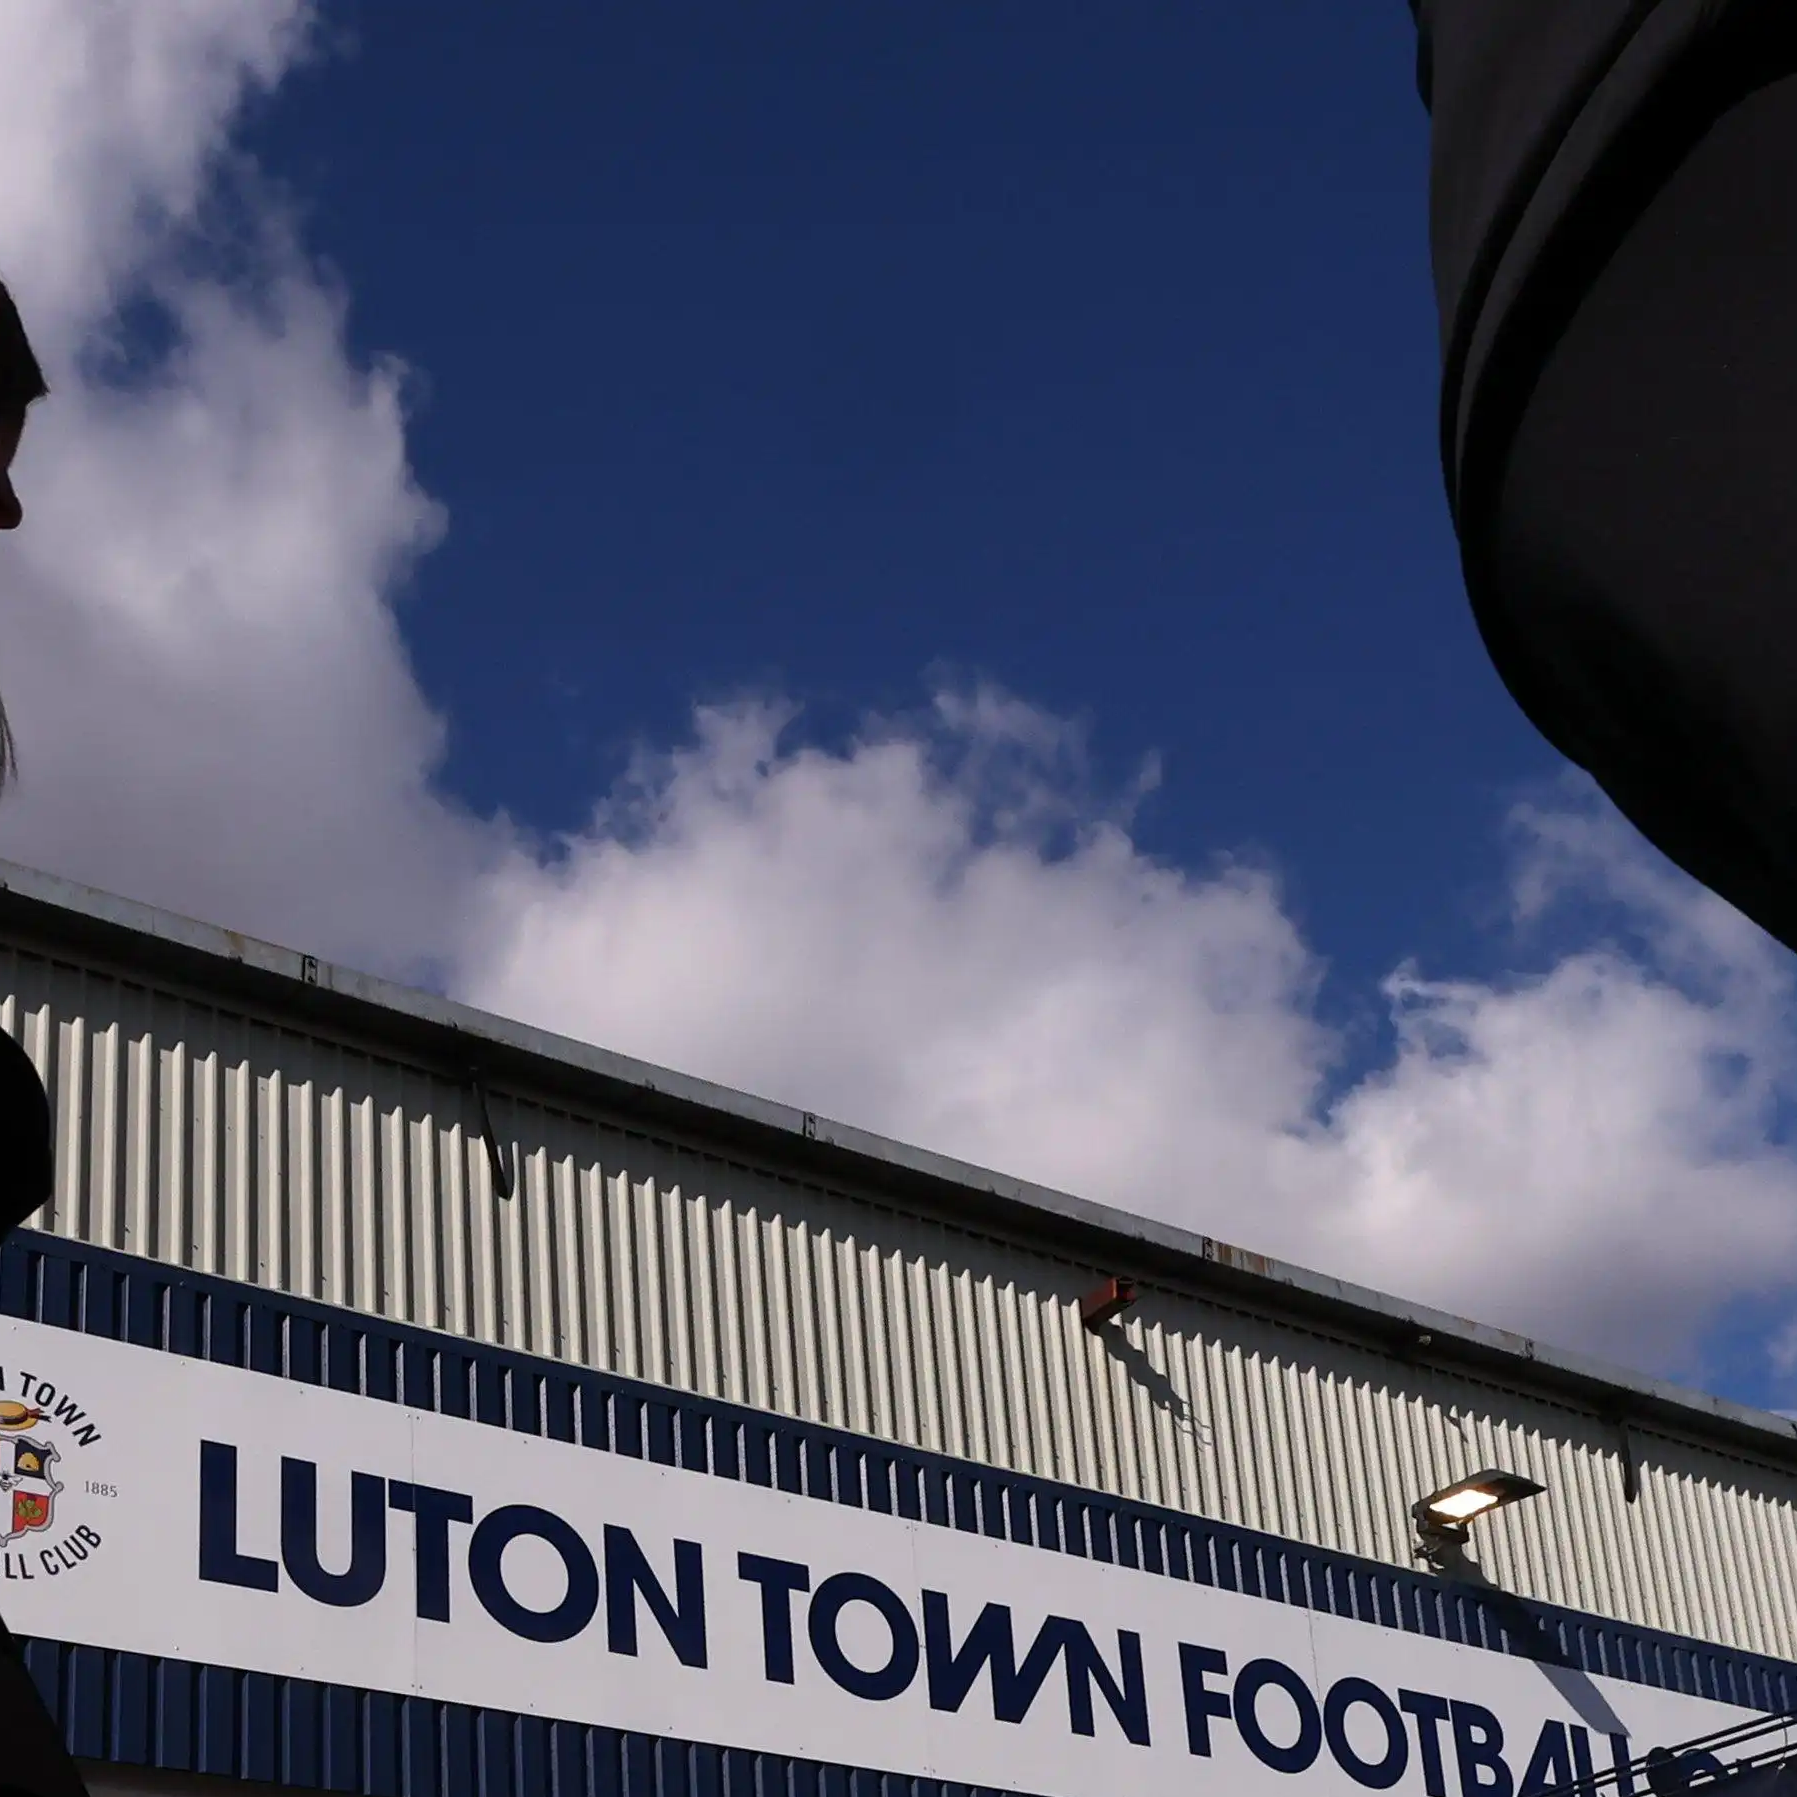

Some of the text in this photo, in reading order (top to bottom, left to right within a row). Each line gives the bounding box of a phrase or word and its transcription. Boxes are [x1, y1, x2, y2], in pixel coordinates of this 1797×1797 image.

[19, 1370, 102, 1448] TOWN
[83, 1480, 119, 1499] 1885
[39, 1523, 102, 1577] CLUB
[198, 1437, 708, 1670] LUTON
[737, 1550, 1150, 1749] TOWN
